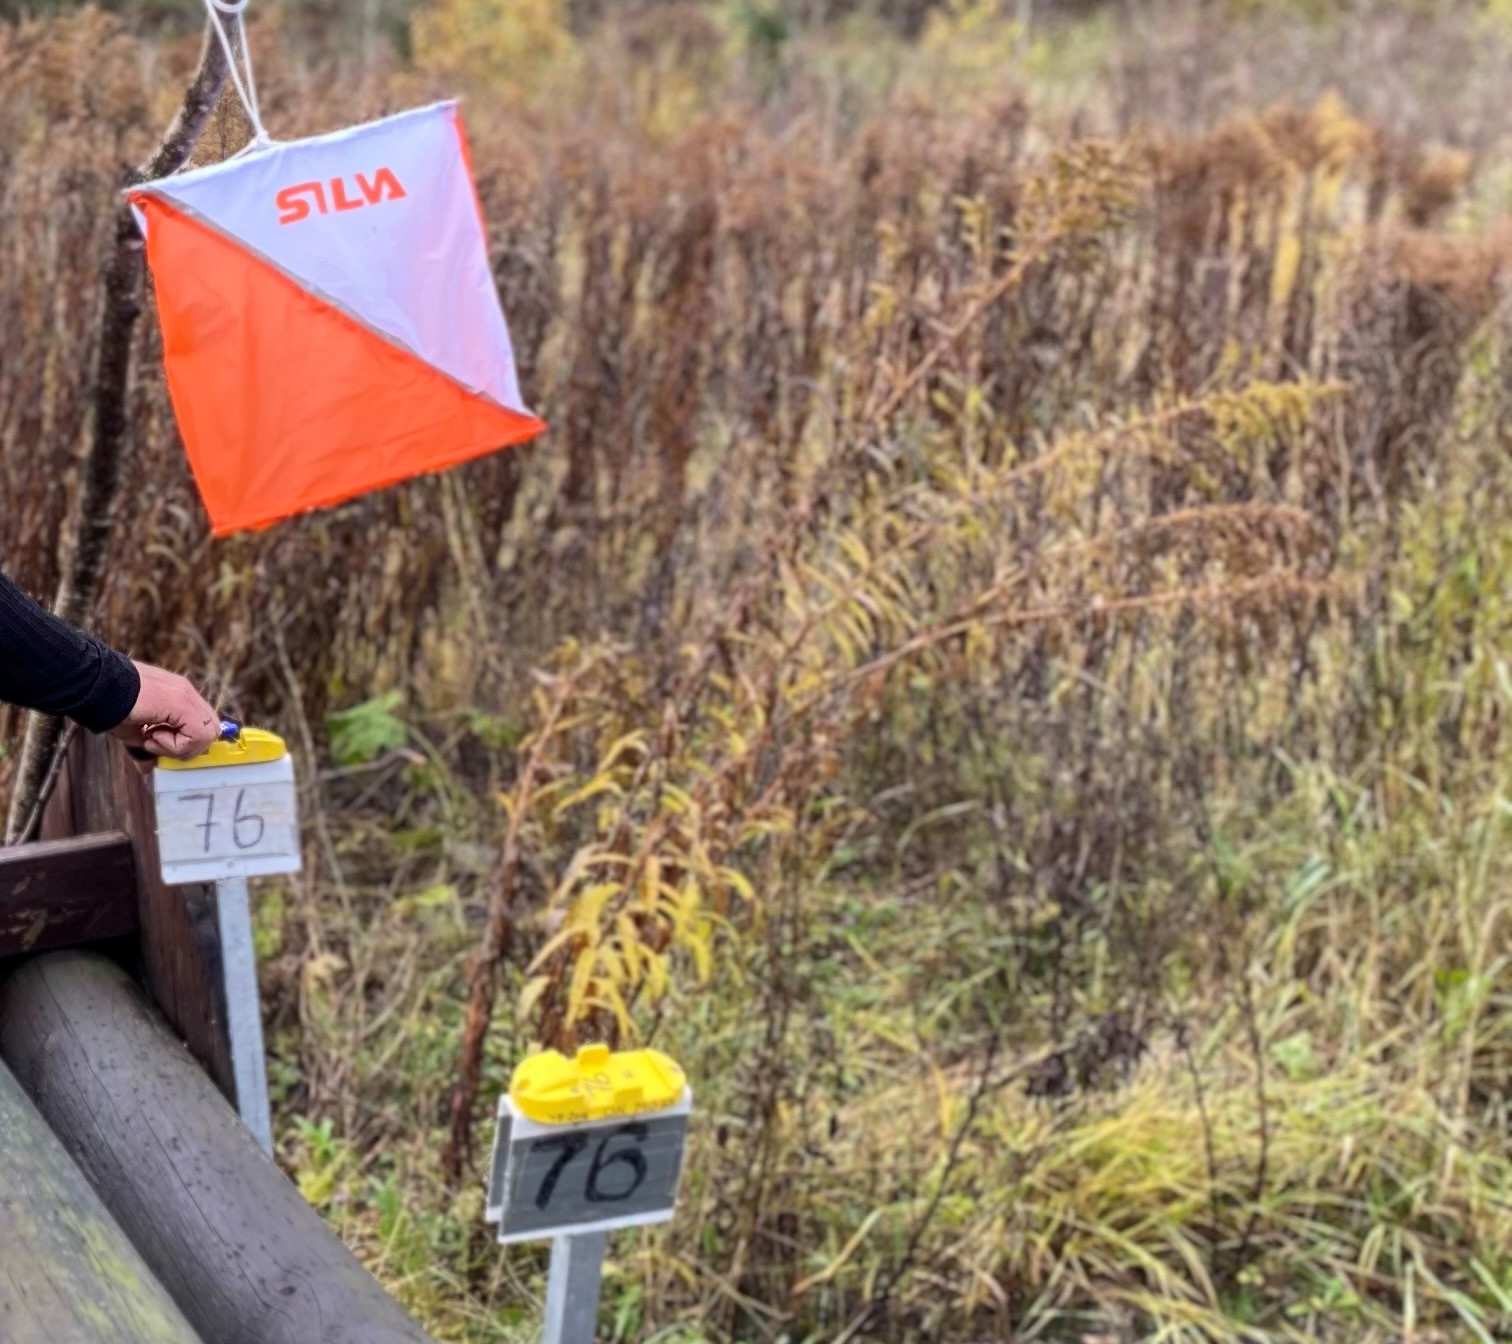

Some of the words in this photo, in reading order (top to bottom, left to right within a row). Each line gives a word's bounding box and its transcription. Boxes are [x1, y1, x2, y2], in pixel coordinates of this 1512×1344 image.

[274, 166, 407, 226] SILVA
[177, 788, 264, 853] 76
[530, 1122, 648, 1211] 76
